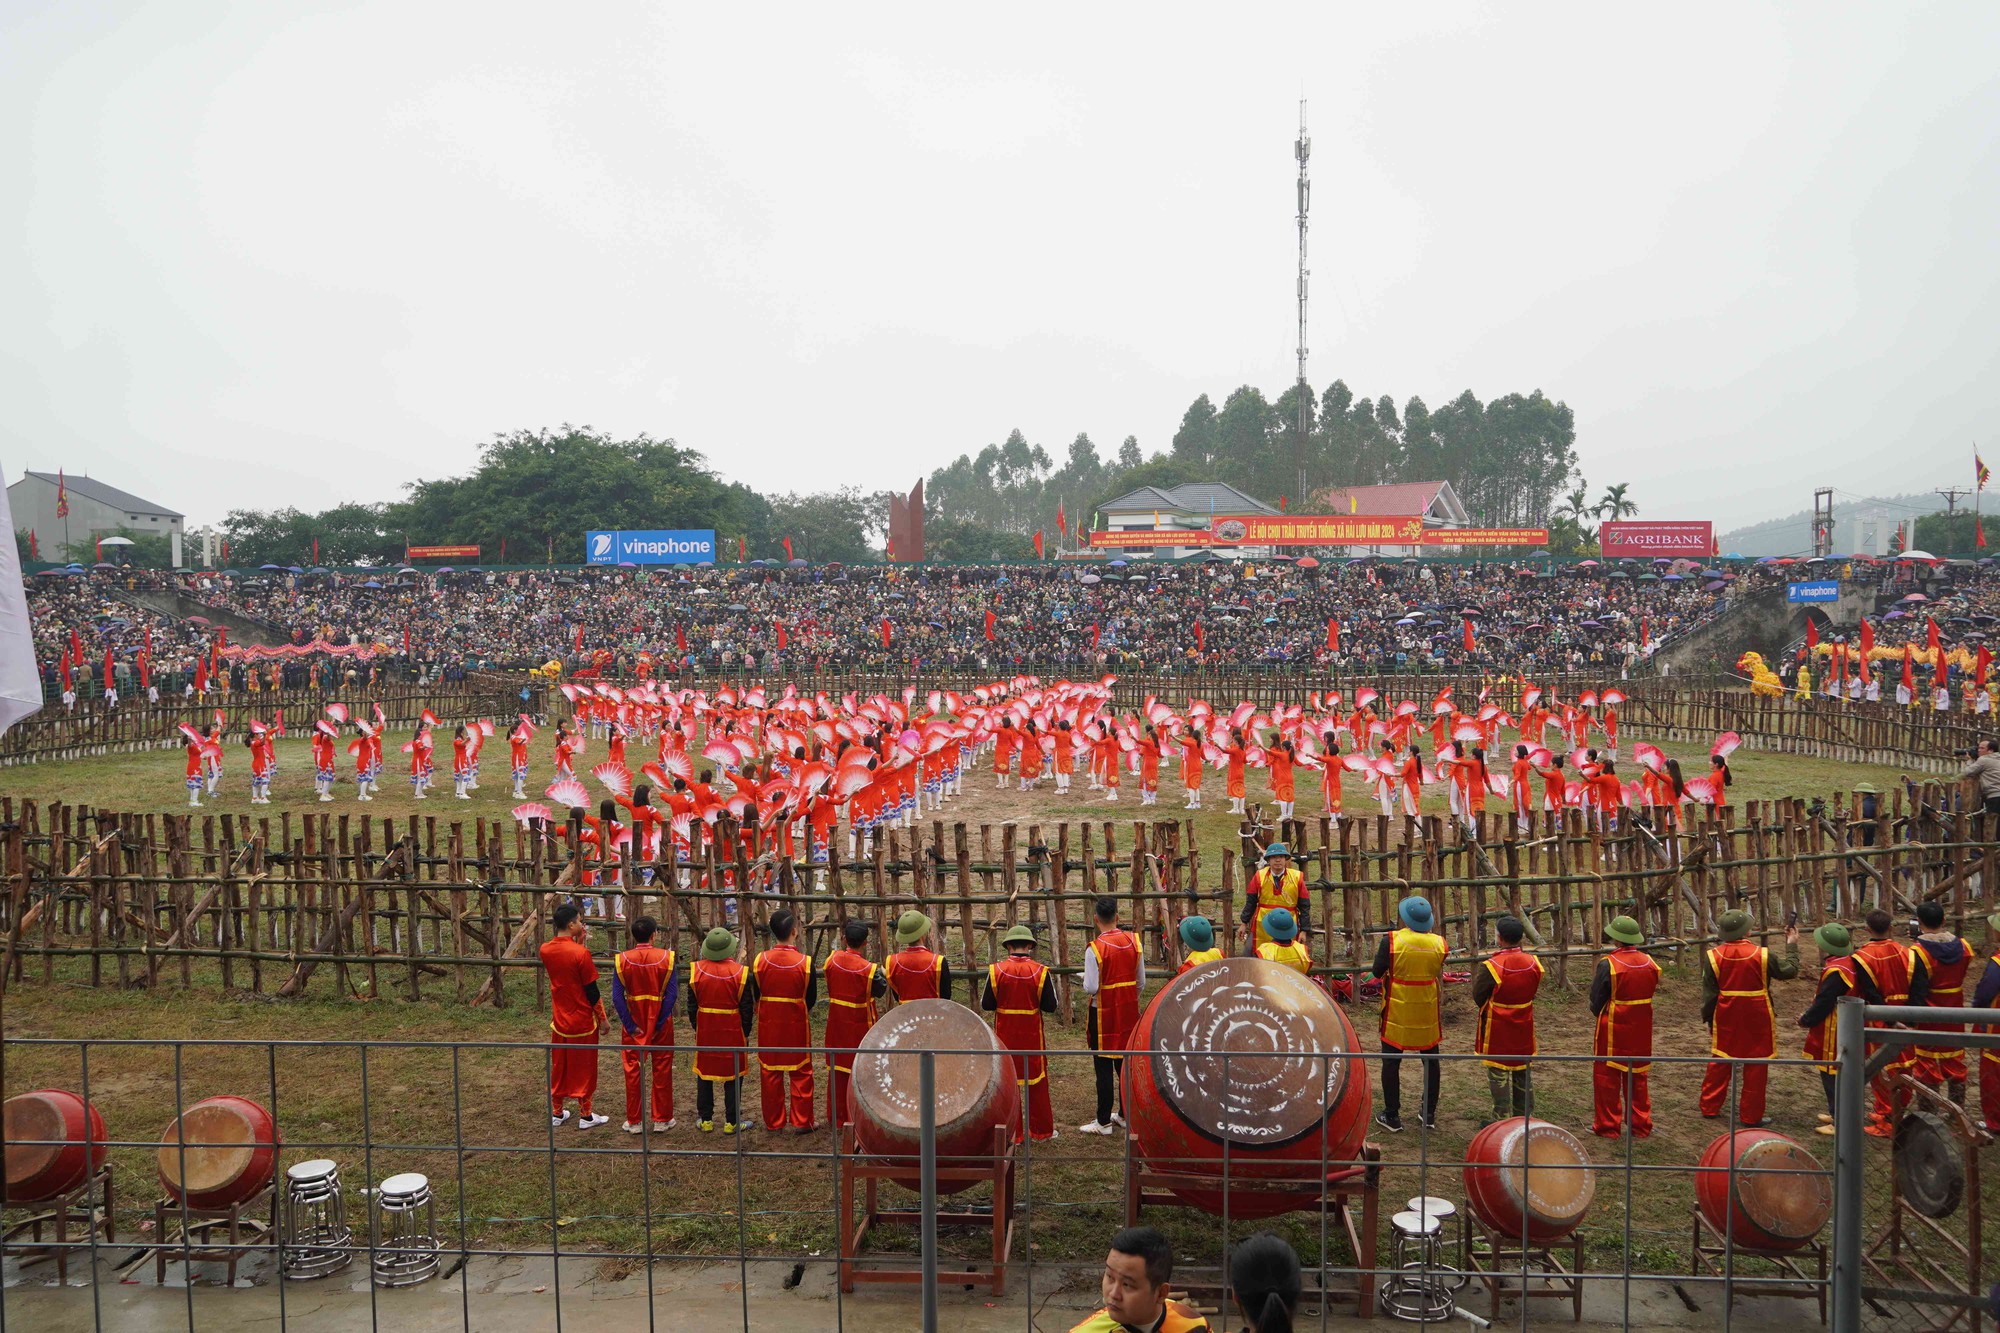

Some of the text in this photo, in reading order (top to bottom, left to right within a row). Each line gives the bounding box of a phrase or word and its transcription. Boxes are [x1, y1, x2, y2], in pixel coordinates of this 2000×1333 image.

[1257, 522, 1267, 541] HỘI
[1268, 524, 1280, 541] CHỌI
[1281, 522, 1296, 538] TRÂU
[1318, 520, 1336, 538] THỐNG
[1337, 522, 1344, 538] XÃ
[1346, 520, 1355, 538] HẢI
[1368, 522, 1380, 538] NĂM
[1382, 524, 1395, 538] 2024
[1624, 535, 1704, 544] AGRIBANK
[623, 538, 710, 556] vinaphone
[1800, 586, 1837, 597] vinaphone
